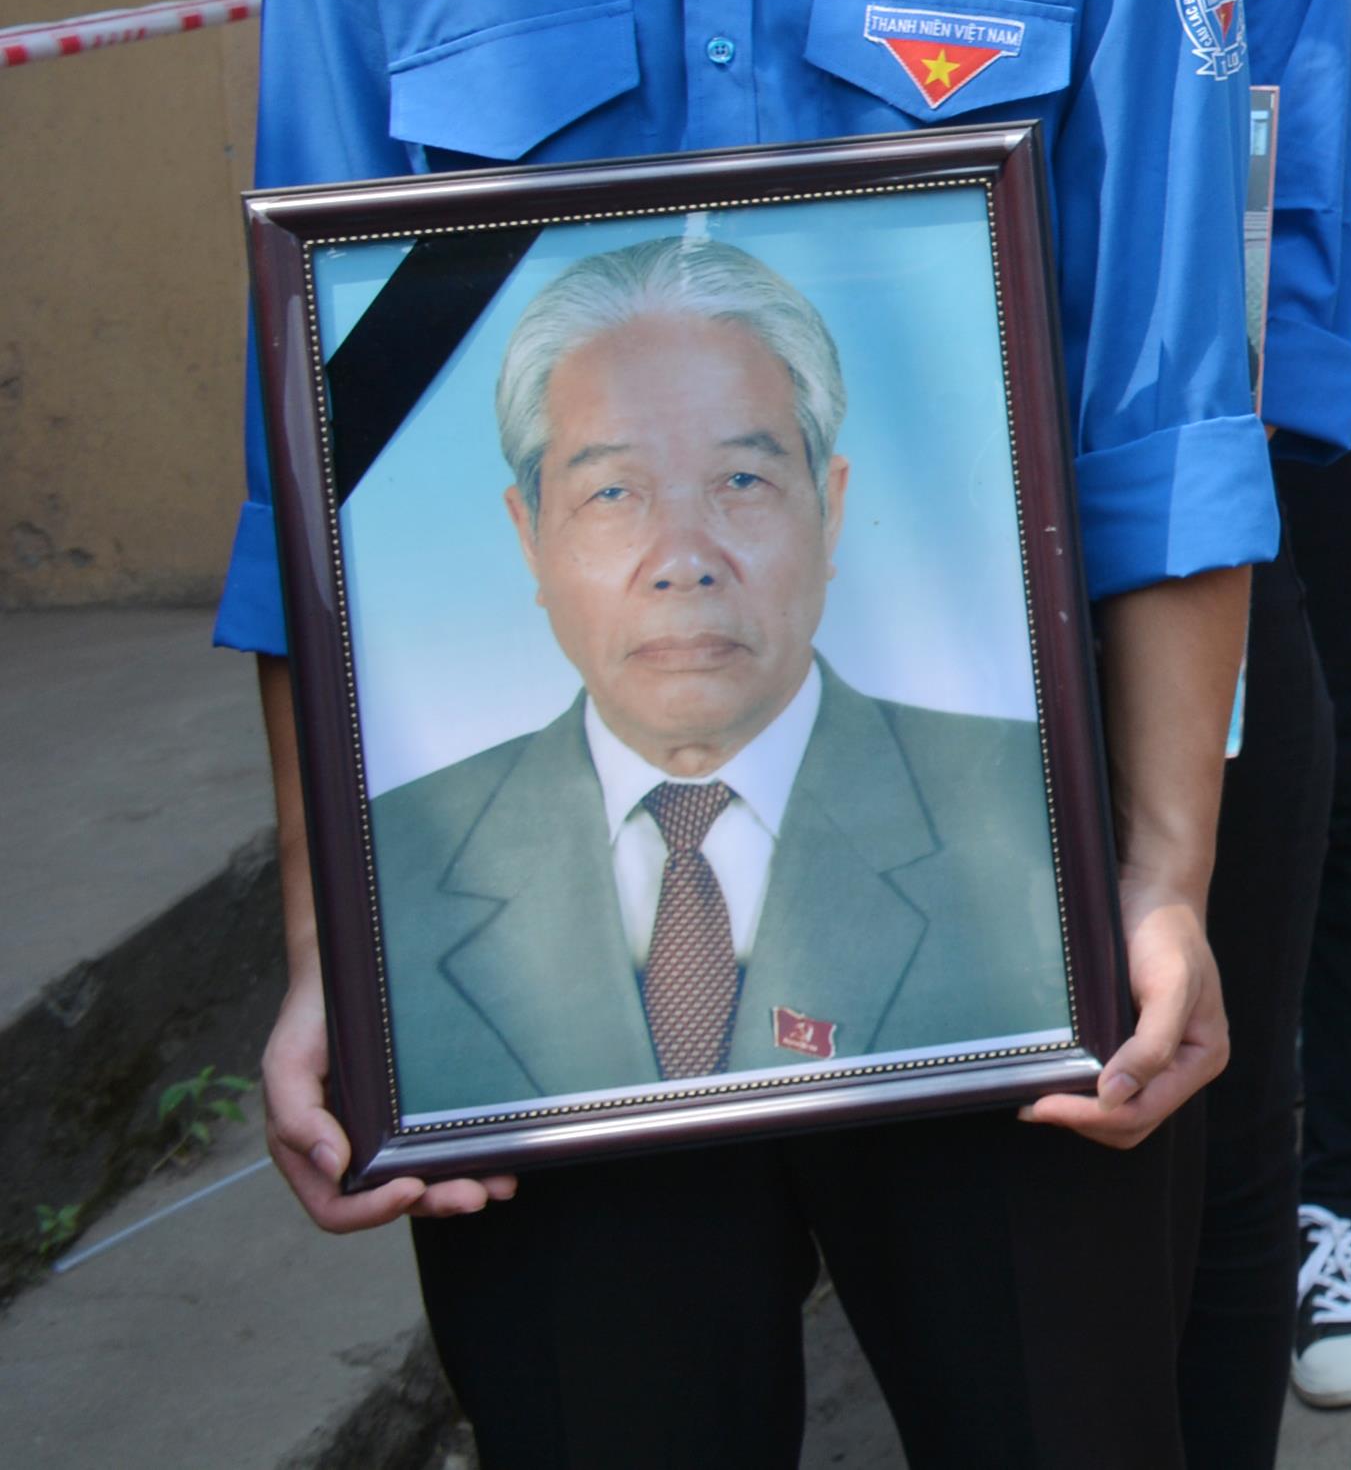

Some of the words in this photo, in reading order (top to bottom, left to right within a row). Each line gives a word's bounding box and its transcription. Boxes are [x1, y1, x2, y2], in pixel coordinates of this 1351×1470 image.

[871, 15, 917, 33] THANH
[919, 18, 951, 38] NIÊN
[954, 23, 986, 44] VIỆT
[986, 28, 1019, 46] NAM
